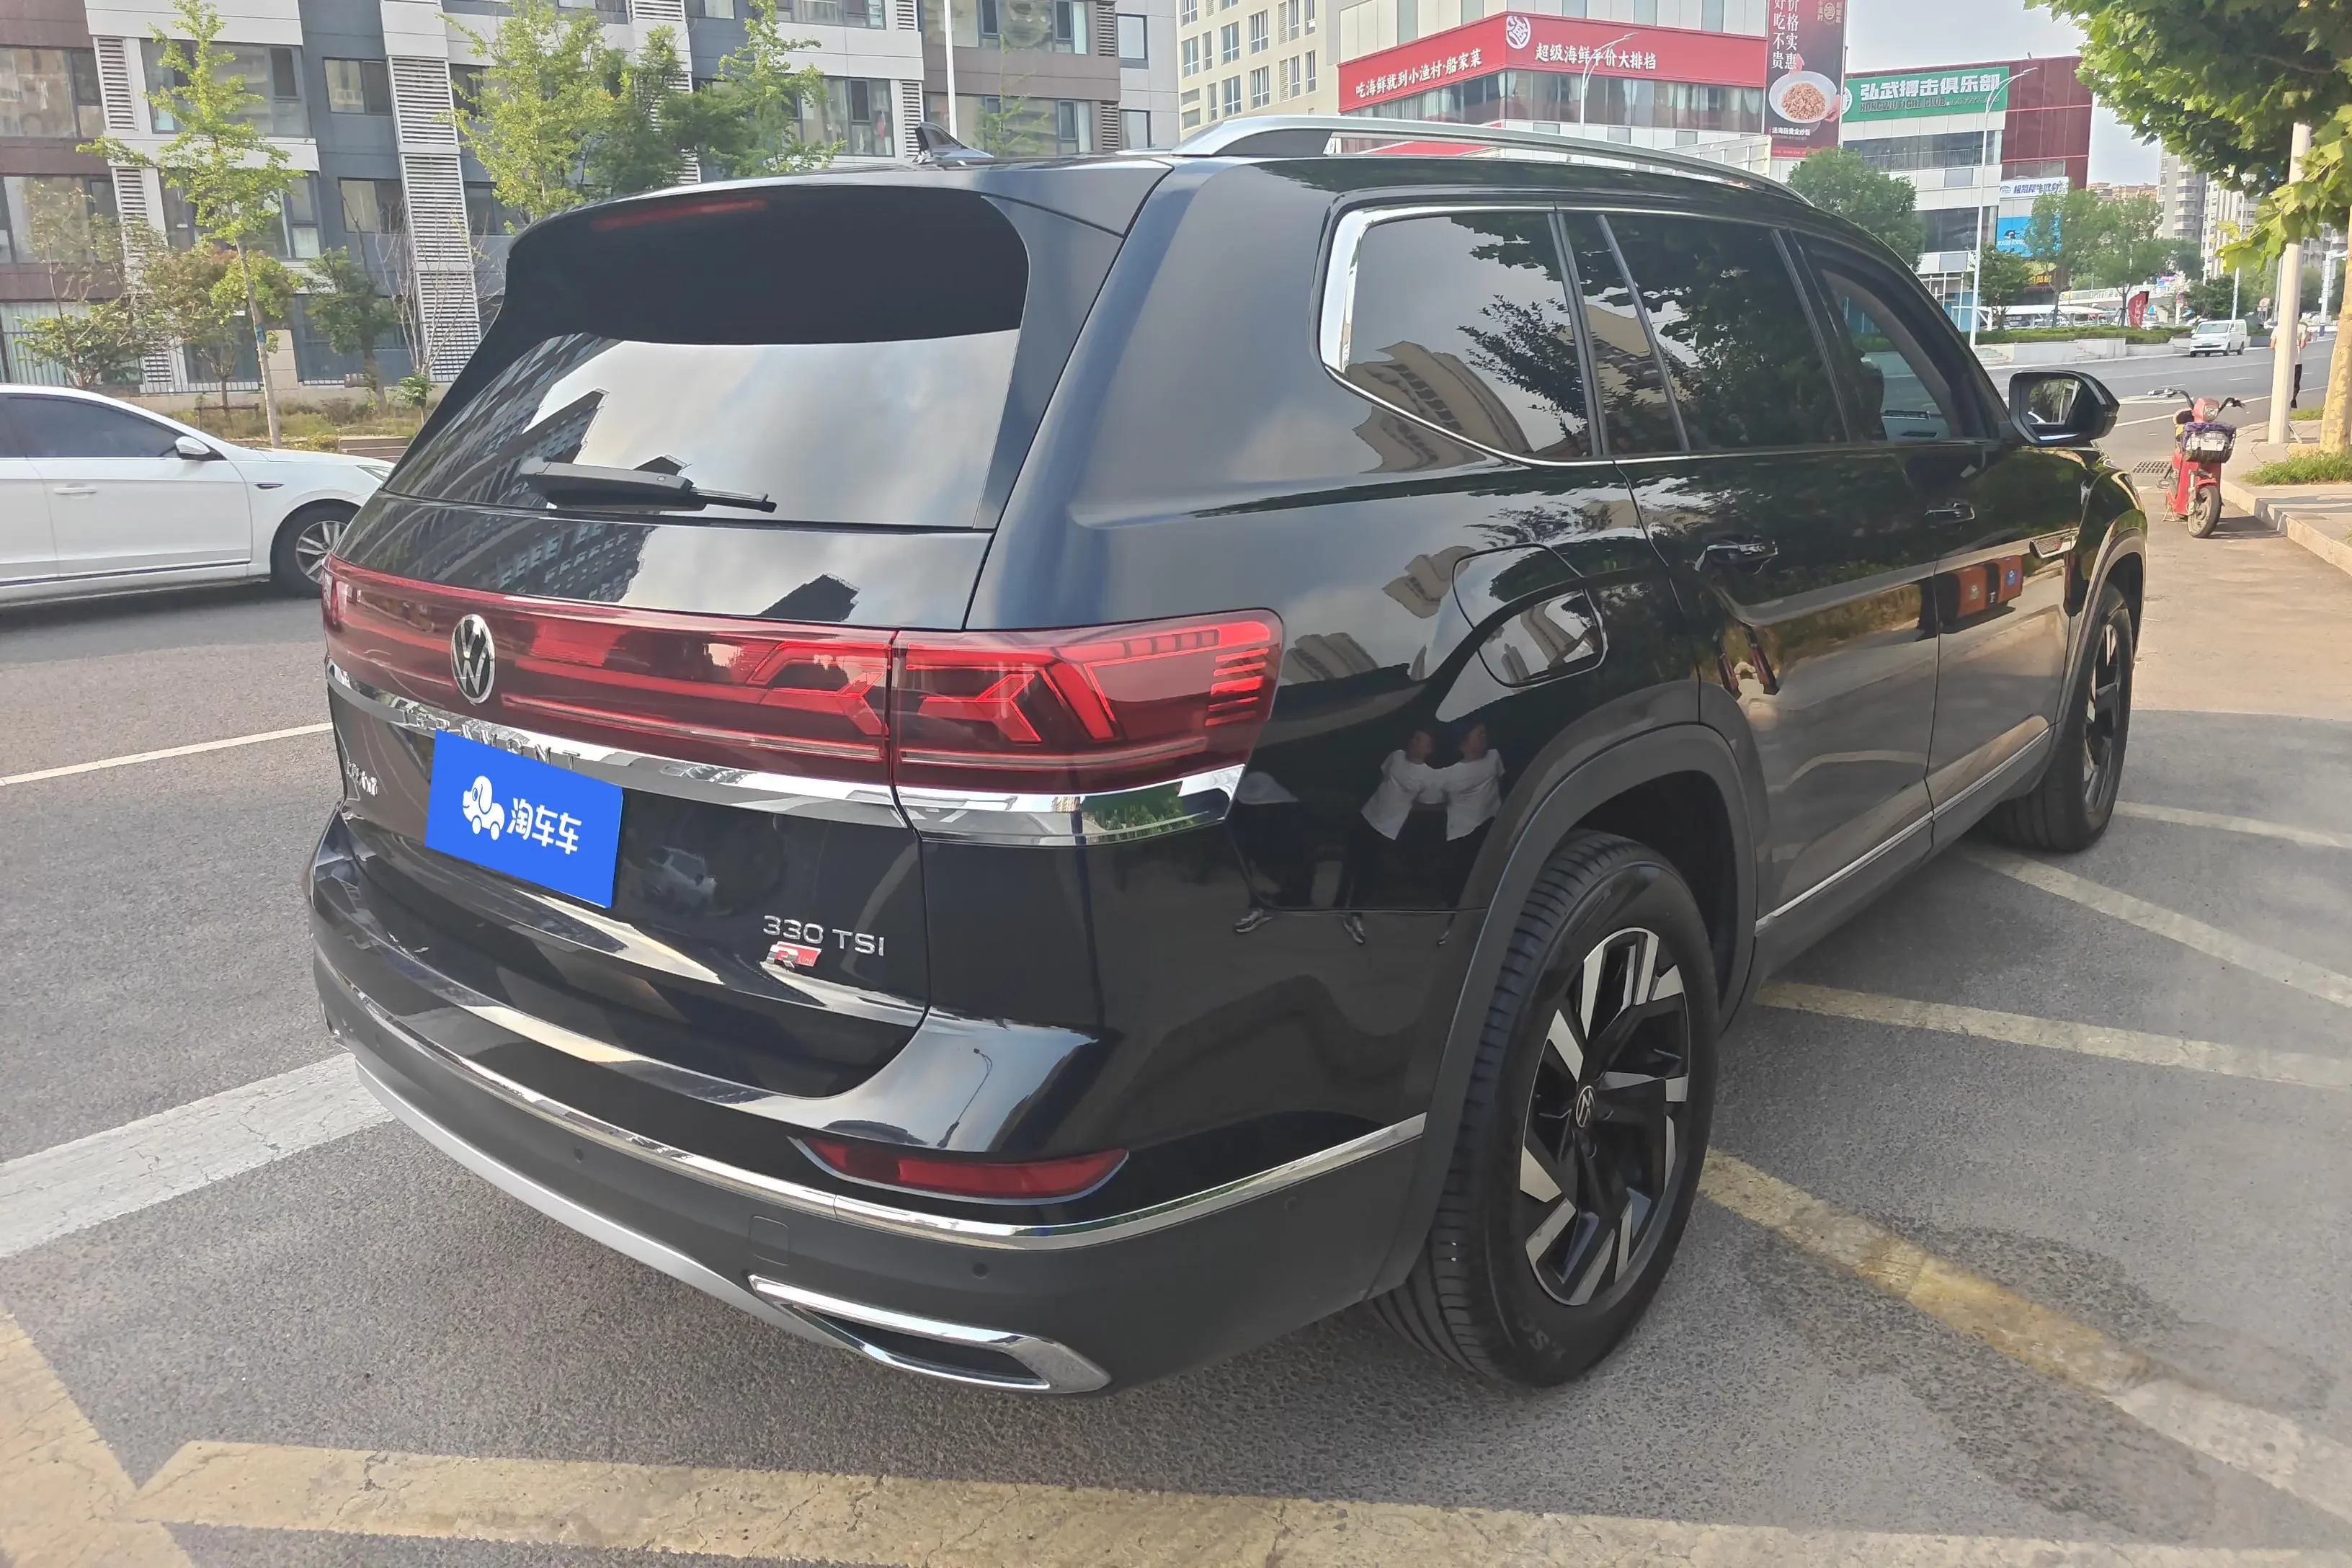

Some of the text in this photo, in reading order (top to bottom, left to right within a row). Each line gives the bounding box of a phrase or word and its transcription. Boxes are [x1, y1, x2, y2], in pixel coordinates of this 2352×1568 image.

[1535, 43, 1657, 70] 超级海鲜平价大排档
[1860, 74, 2000, 101] 弘武搏击俱乐部
[762, 914, 885, 957] 330 TSI
